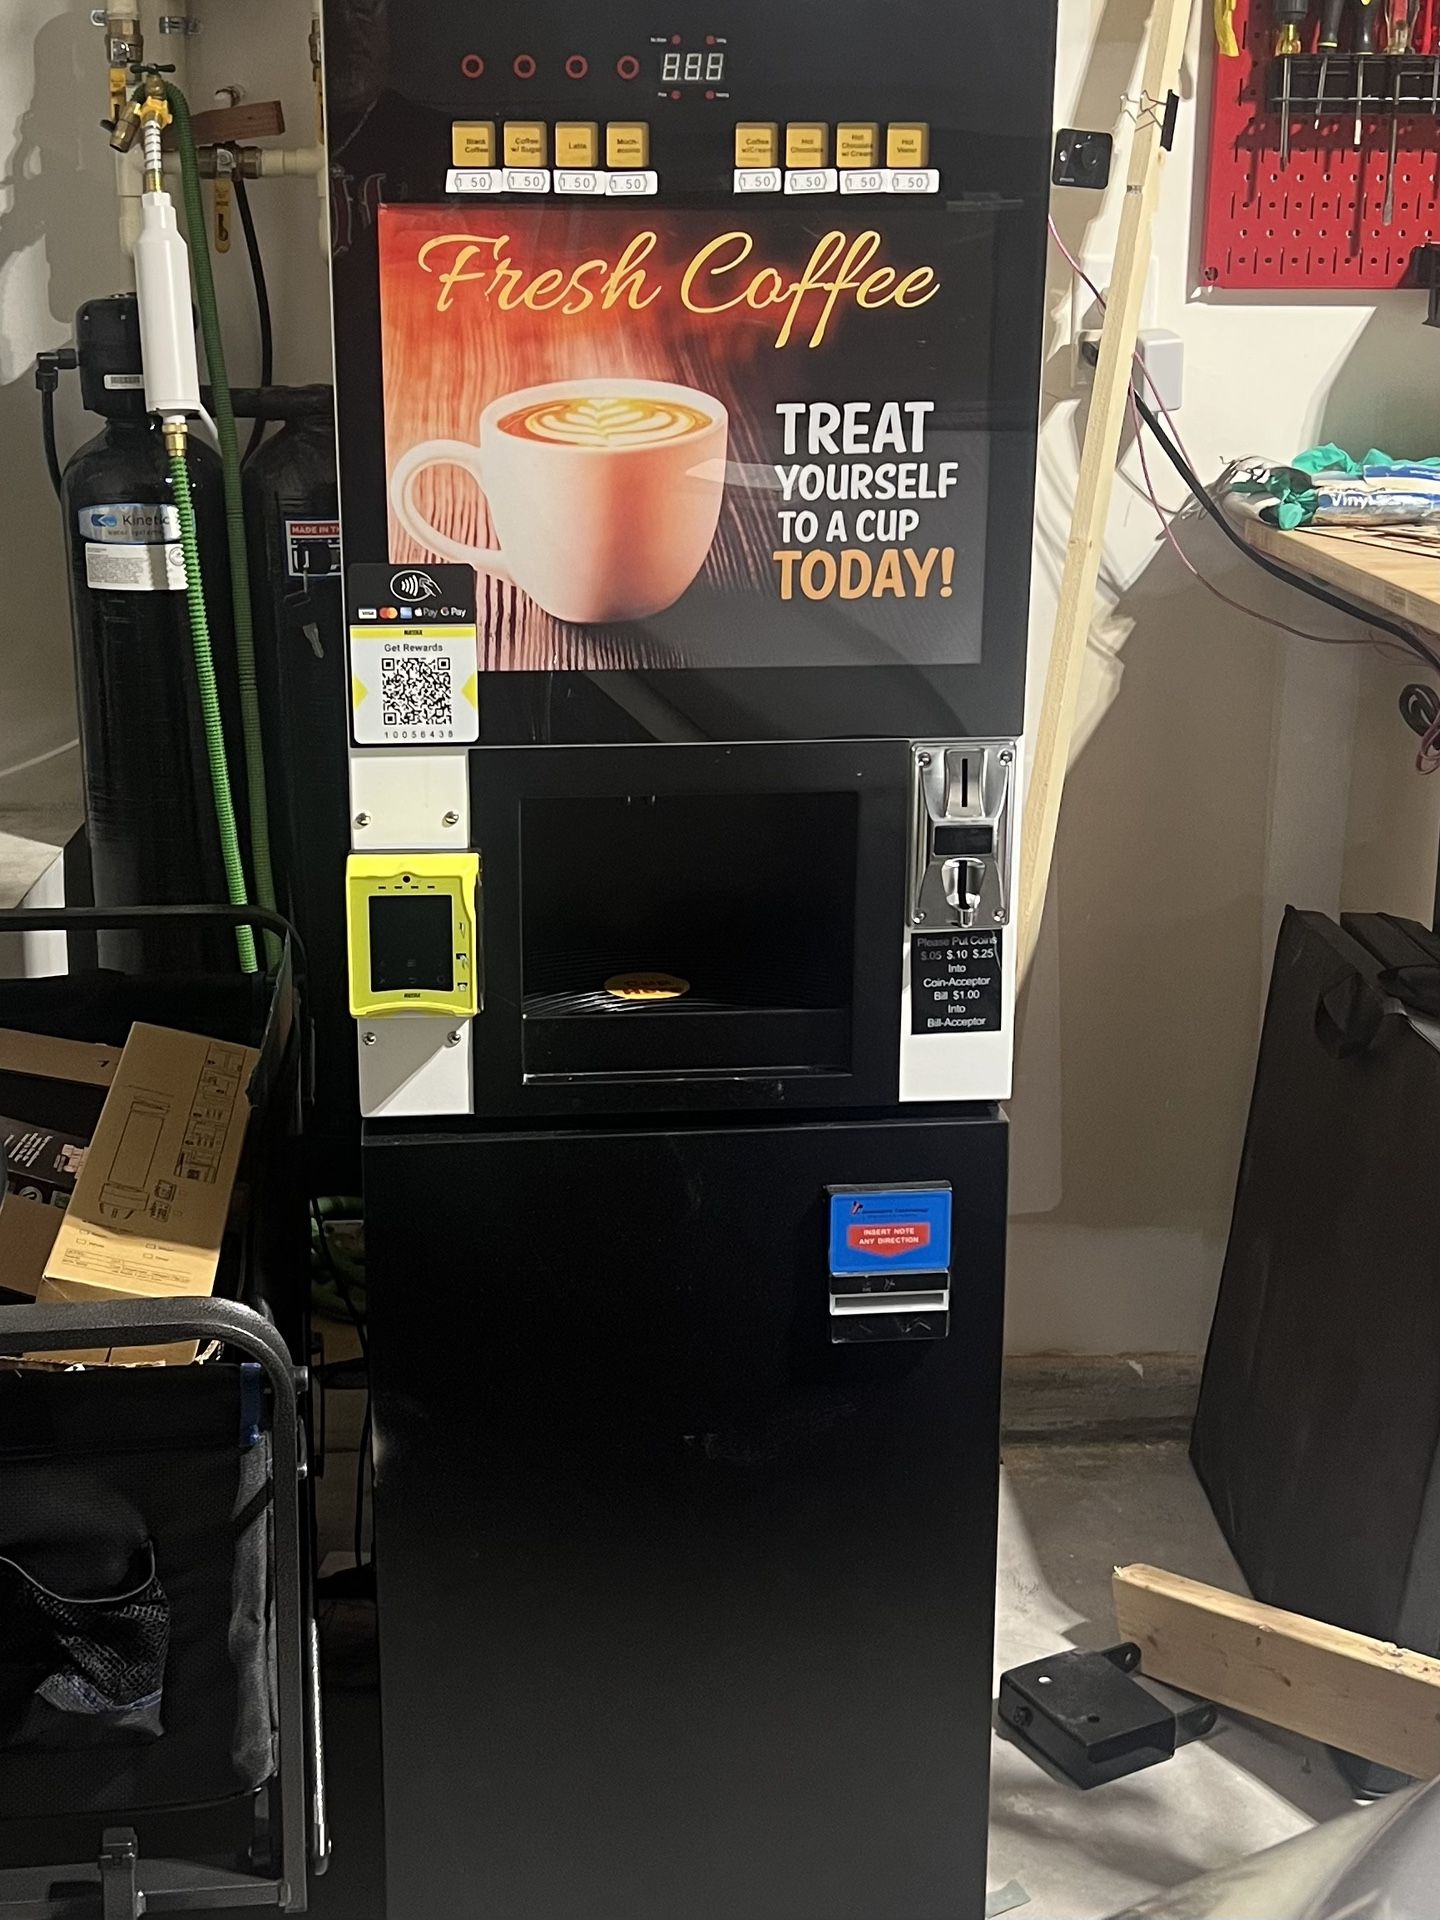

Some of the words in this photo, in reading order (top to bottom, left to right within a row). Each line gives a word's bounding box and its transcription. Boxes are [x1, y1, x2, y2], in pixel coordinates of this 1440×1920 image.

[515, 137, 539, 145] Coffee
[417, 231, 662, 315] Fresh
[680, 230, 941, 349] Coffee
[775, 401, 935, 455] TREAT
[773, 461, 959, 502] YOURSELF
[292, 526, 317, 534] MADE
[777, 511, 818, 543] TO
[825, 511, 848, 542] A
[855, 510, 920, 542] CUP
[773, 547, 955, 600] TODAY!
[423, 608, 438, 619] Pay
[451, 607, 467, 618] Pay
[384, 644, 400, 652] Get
[403, 643, 443, 652] Rewards
[917, 938, 949, 947] Please
[951, 936, 969, 946] Put
[970, 935, 998, 945] Coins
[946, 949, 968, 960] $.10
[972, 948, 994, 959] $.25
[948, 964, 967, 973] Into
[923, 977, 991, 988] Coin-Acceptor
[933, 991, 948, 1001] Bill
[952, 989, 980, 1000] $1.00
[947, 1004, 966, 1014] Into
[927, 1017, 986, 1028] Bill-Acceptor
[863, 1228, 891, 1236] INSERT
[893, 1227, 915, 1235] NOTE
[877, 1236, 919, 1244] DIRECTION
